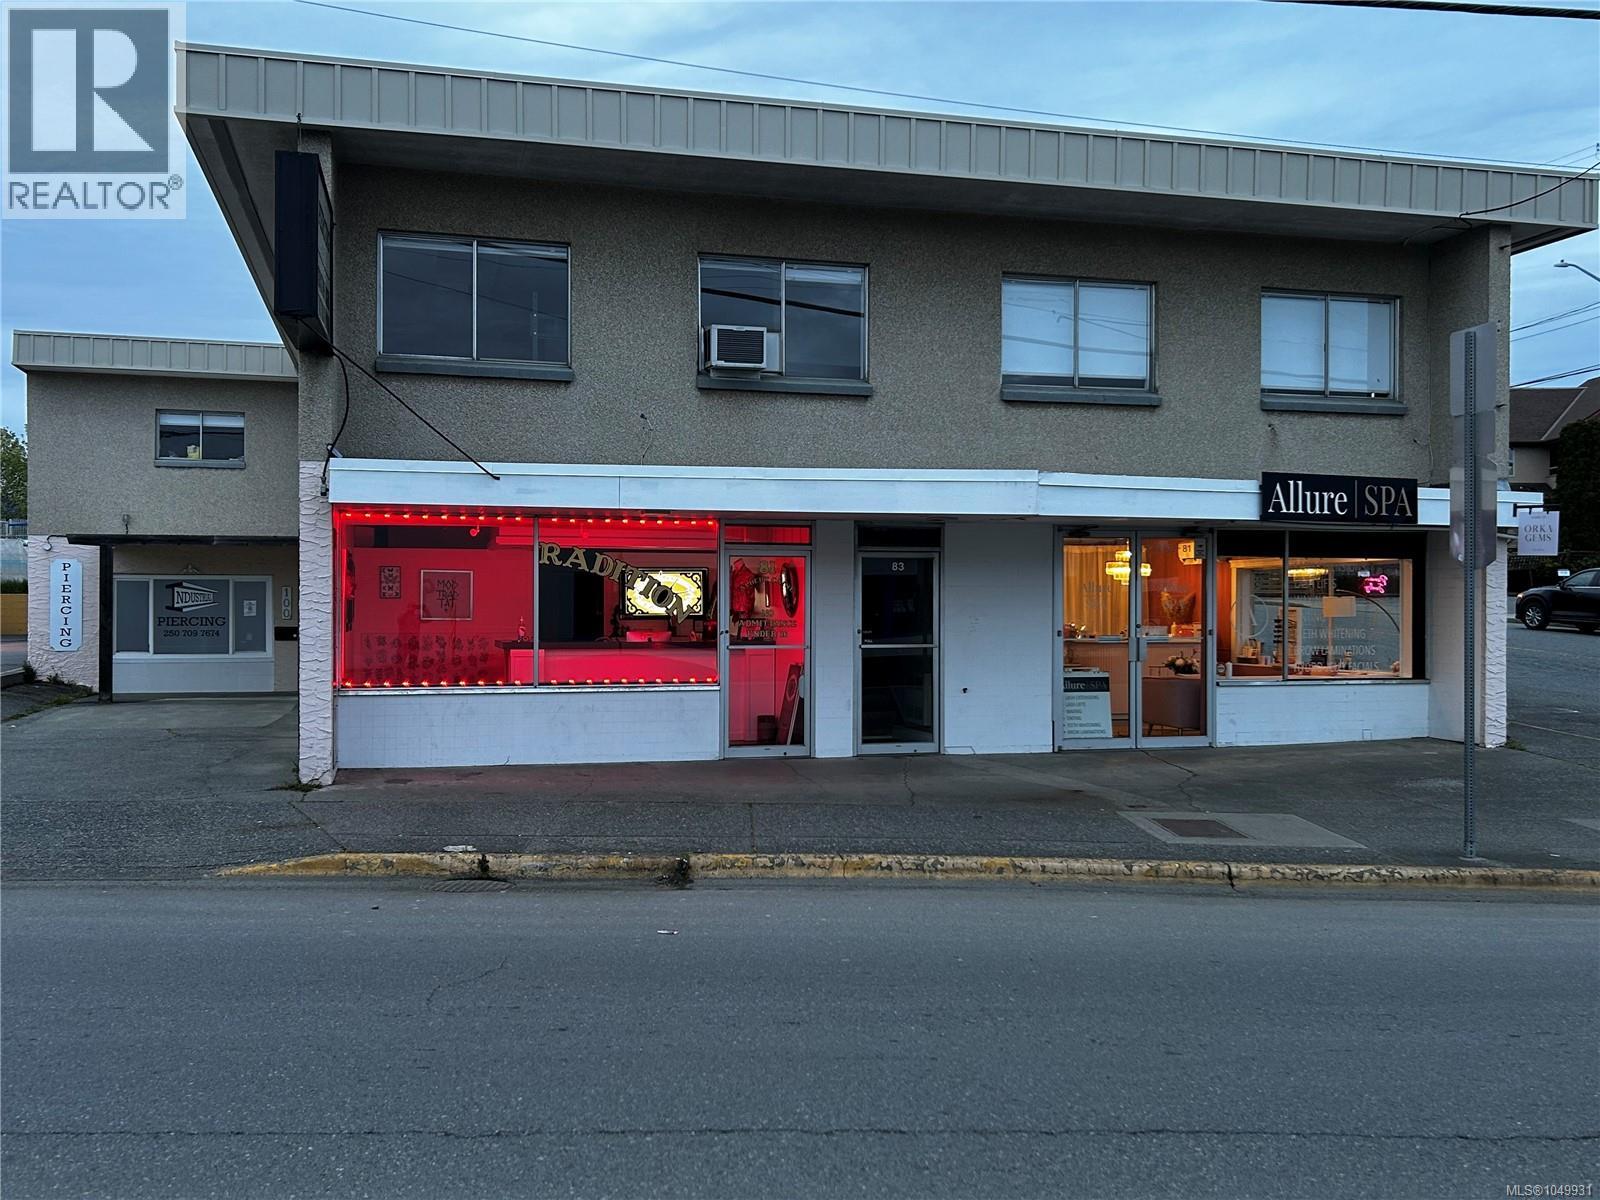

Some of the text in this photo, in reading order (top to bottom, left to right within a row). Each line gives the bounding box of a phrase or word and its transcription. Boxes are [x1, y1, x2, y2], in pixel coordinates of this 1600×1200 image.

[1268, 480, 1413, 517] Allure SPA
[1524, 524, 1553, 533] ORKA
[1524, 534, 1552, 542] GEMS
[891, 562, 905, 571] 83
[59, 562, 72, 647] PIERCING
[157, 617, 226, 626] PIERCING
